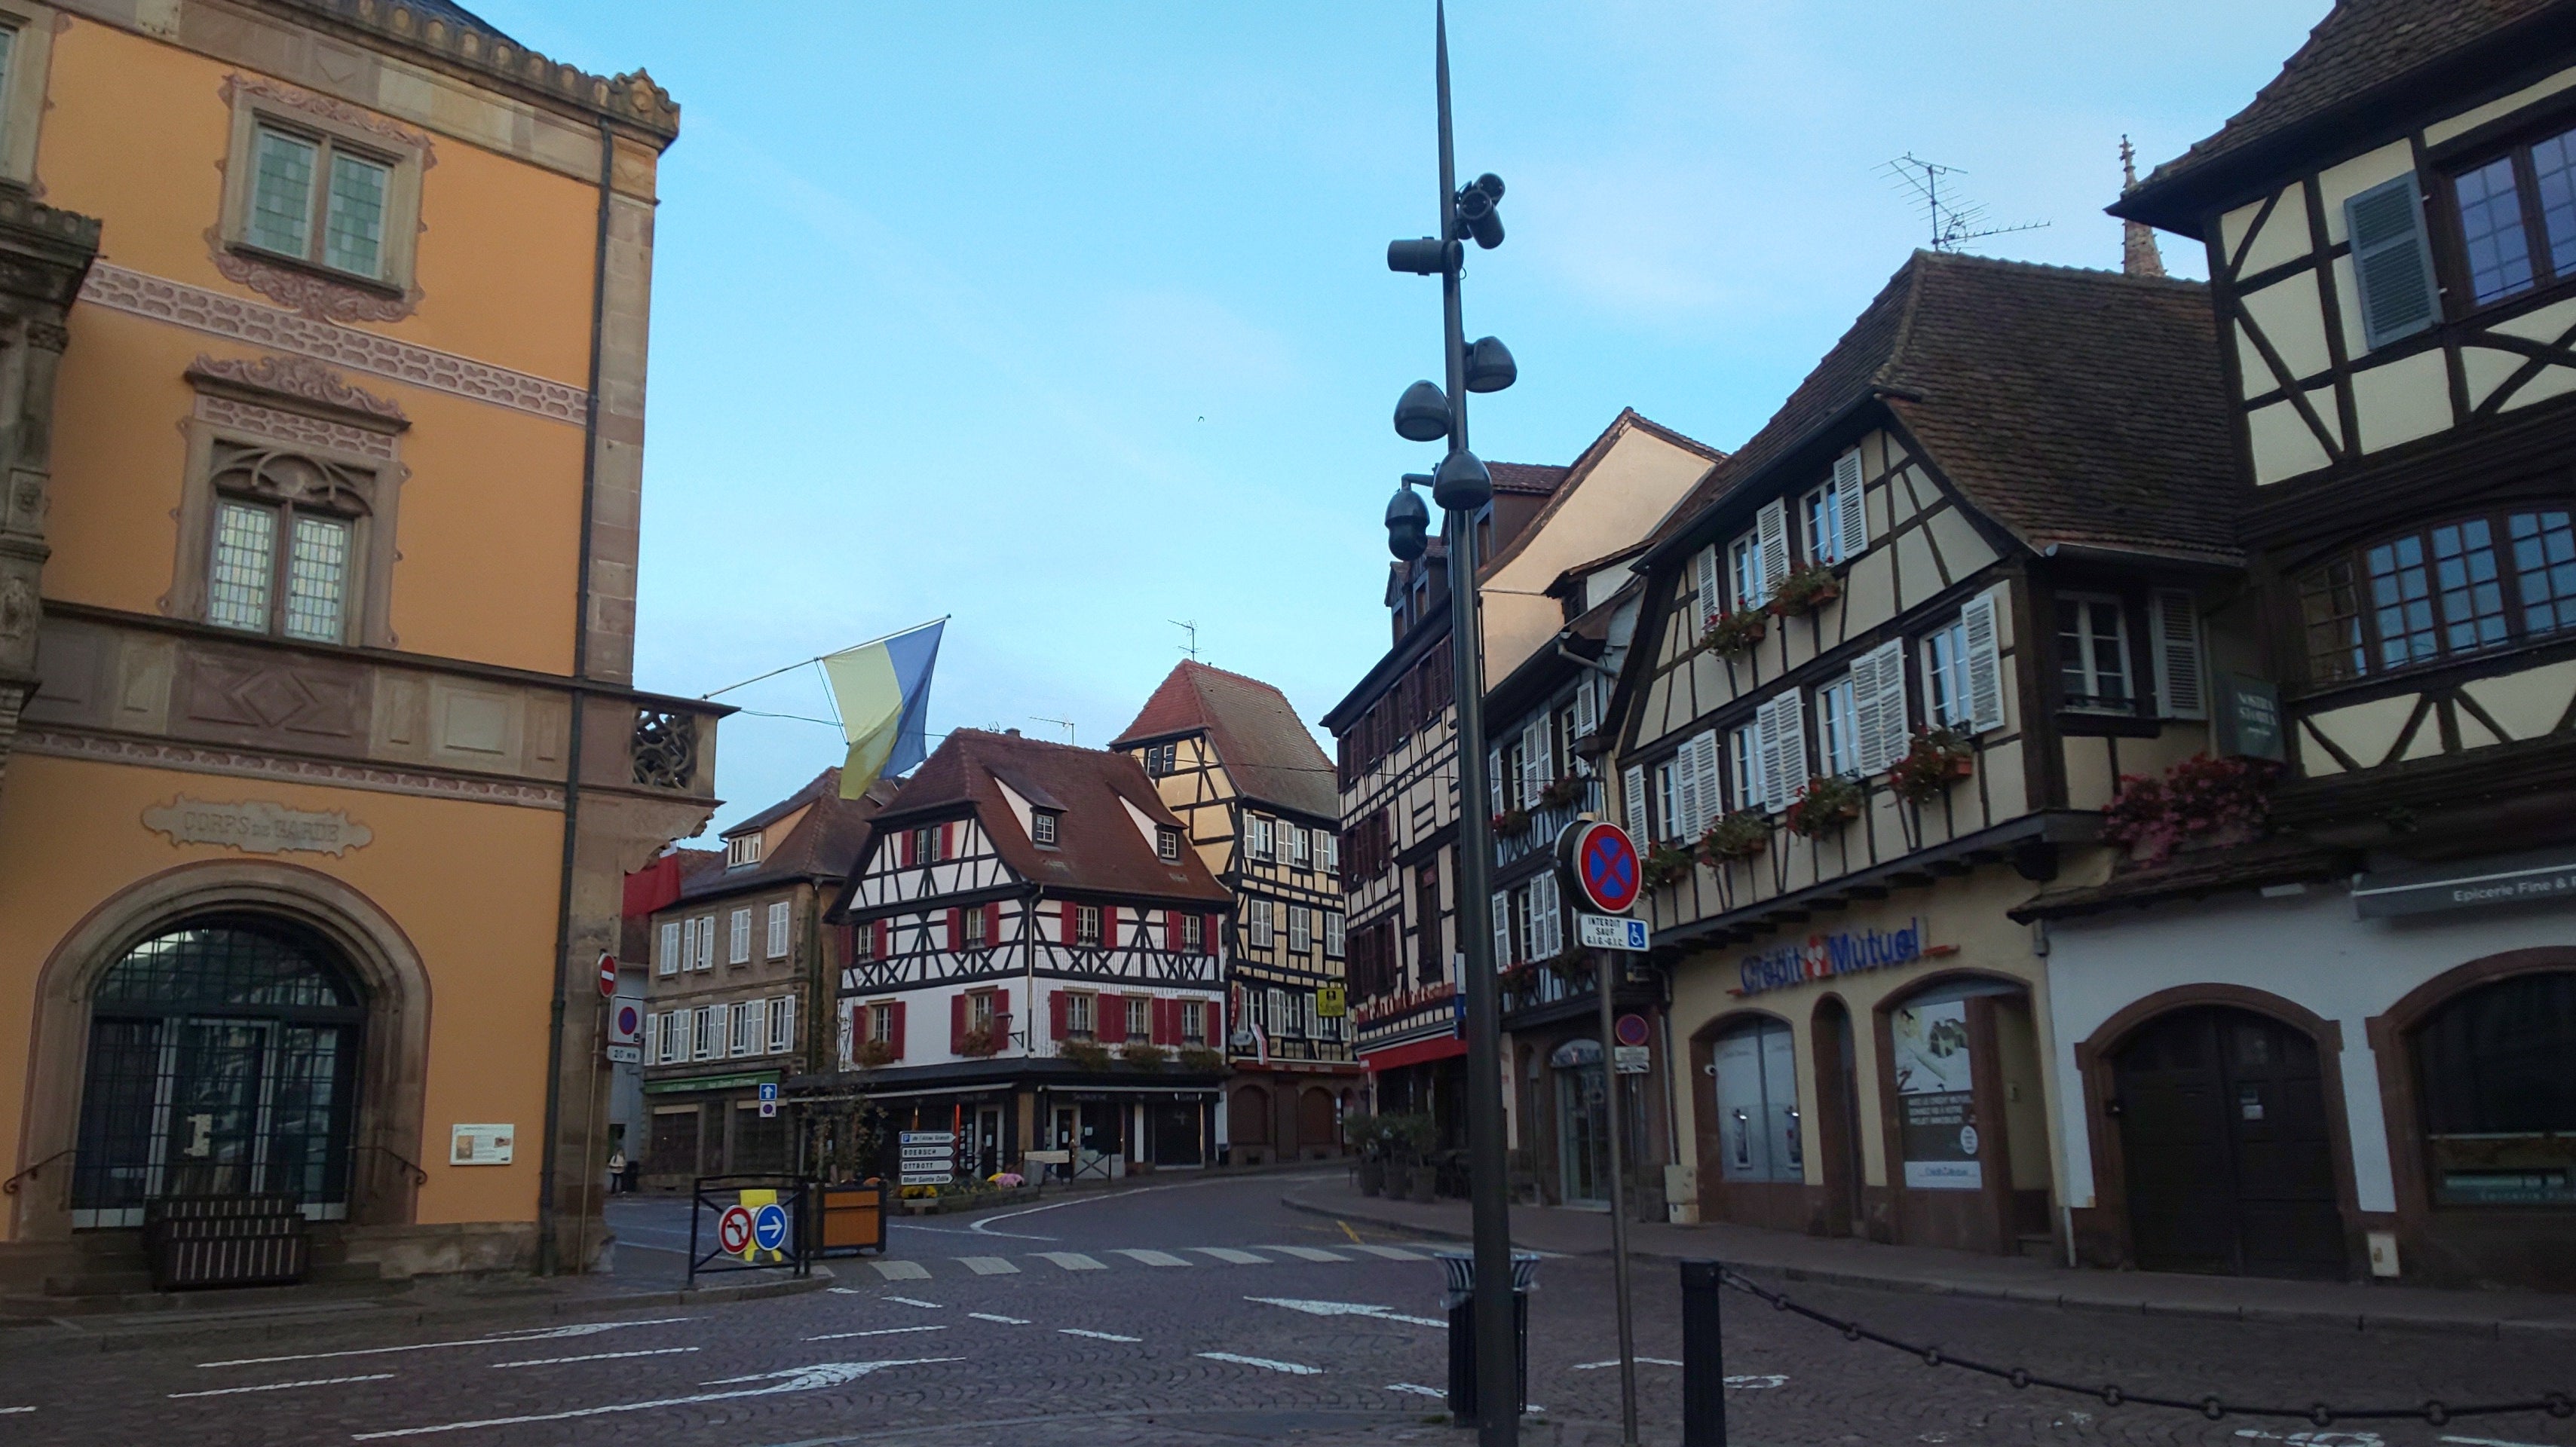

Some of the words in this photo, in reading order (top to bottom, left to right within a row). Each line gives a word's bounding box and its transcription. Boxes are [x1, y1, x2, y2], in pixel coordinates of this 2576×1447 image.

[184, 811, 250, 834] CORPS
[274, 818, 339, 842] GARDE
[2518, 881, 2553, 894] Fine
[2556, 877, 2567, 889] &
[1588, 917, 1620, 928] INTERDIT
[1595, 926, 1614, 936] SAUF
[1827, 916, 1920, 974] Mutuel
